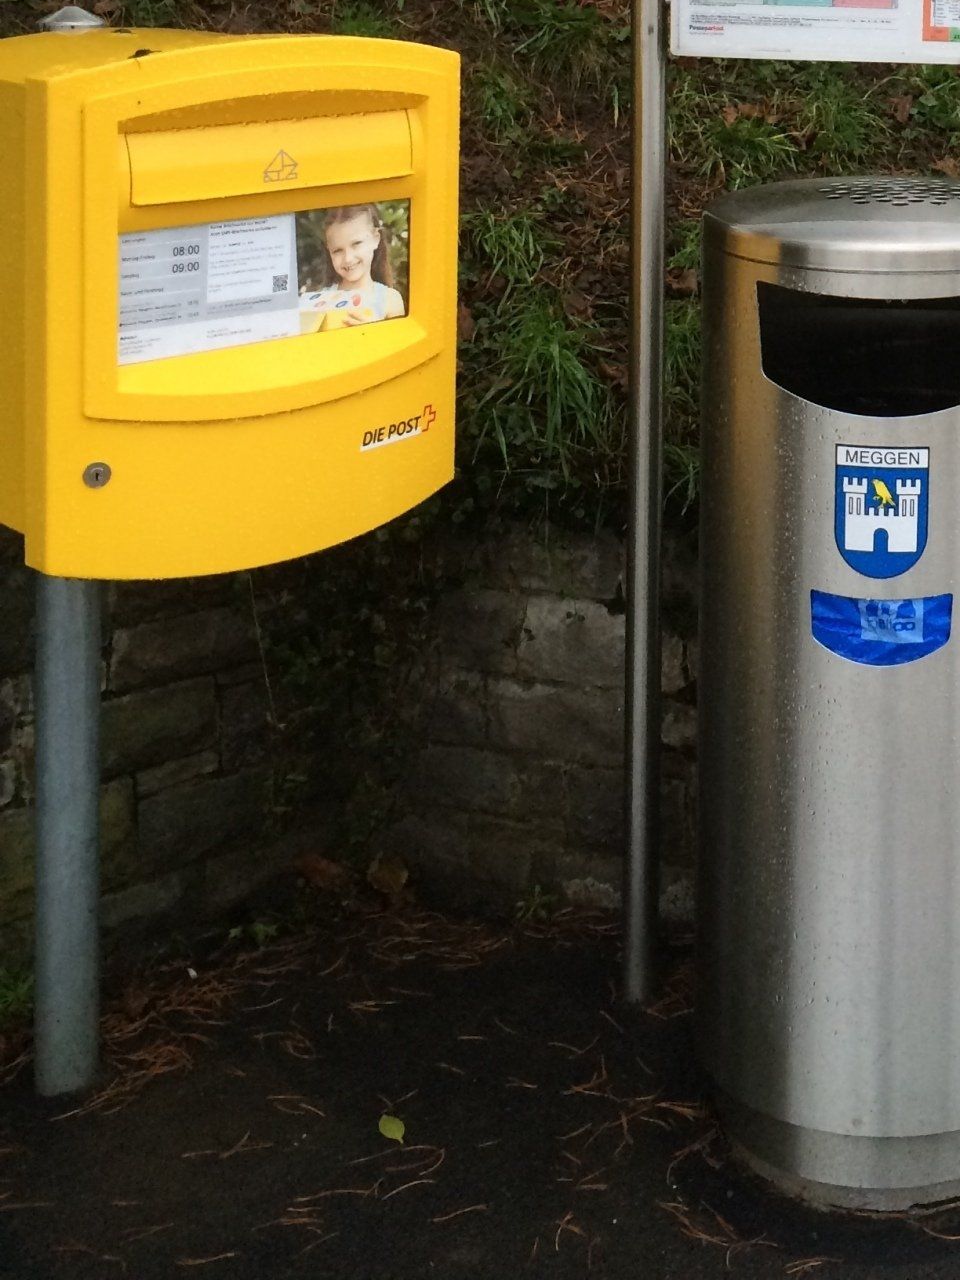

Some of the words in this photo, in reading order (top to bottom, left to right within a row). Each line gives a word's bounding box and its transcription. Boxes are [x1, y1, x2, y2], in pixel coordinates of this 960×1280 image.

[362, 426, 386, 447] DIE
[387, 415, 422, 439] POST
[845, 450, 920, 465] MEGGEN
